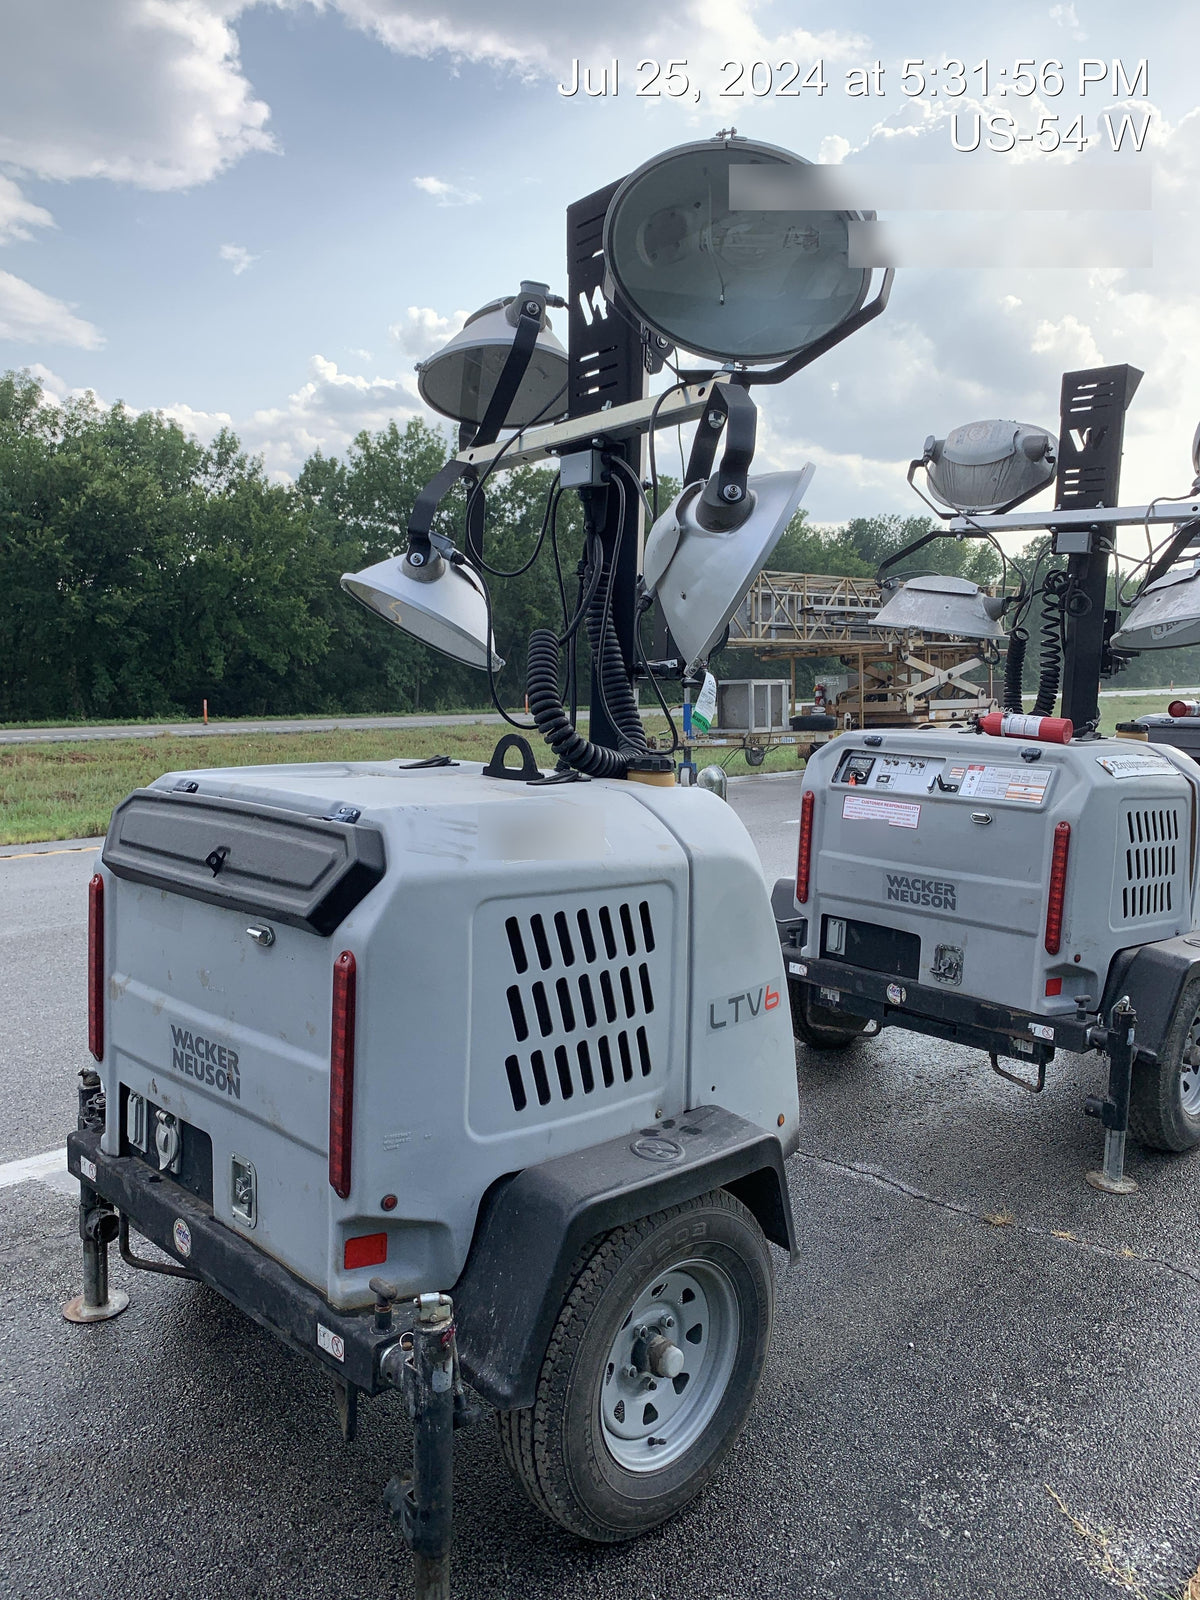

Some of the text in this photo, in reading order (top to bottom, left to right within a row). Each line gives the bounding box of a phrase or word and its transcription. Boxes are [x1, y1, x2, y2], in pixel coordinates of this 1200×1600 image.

[886, 873, 957, 898] WACKER
[887, 887, 957, 911] NEUSON
[709, 985, 780, 1030] LTV6
[170, 1023, 241, 1076] WACKER
[172, 1047, 241, 1100] NEUSON
